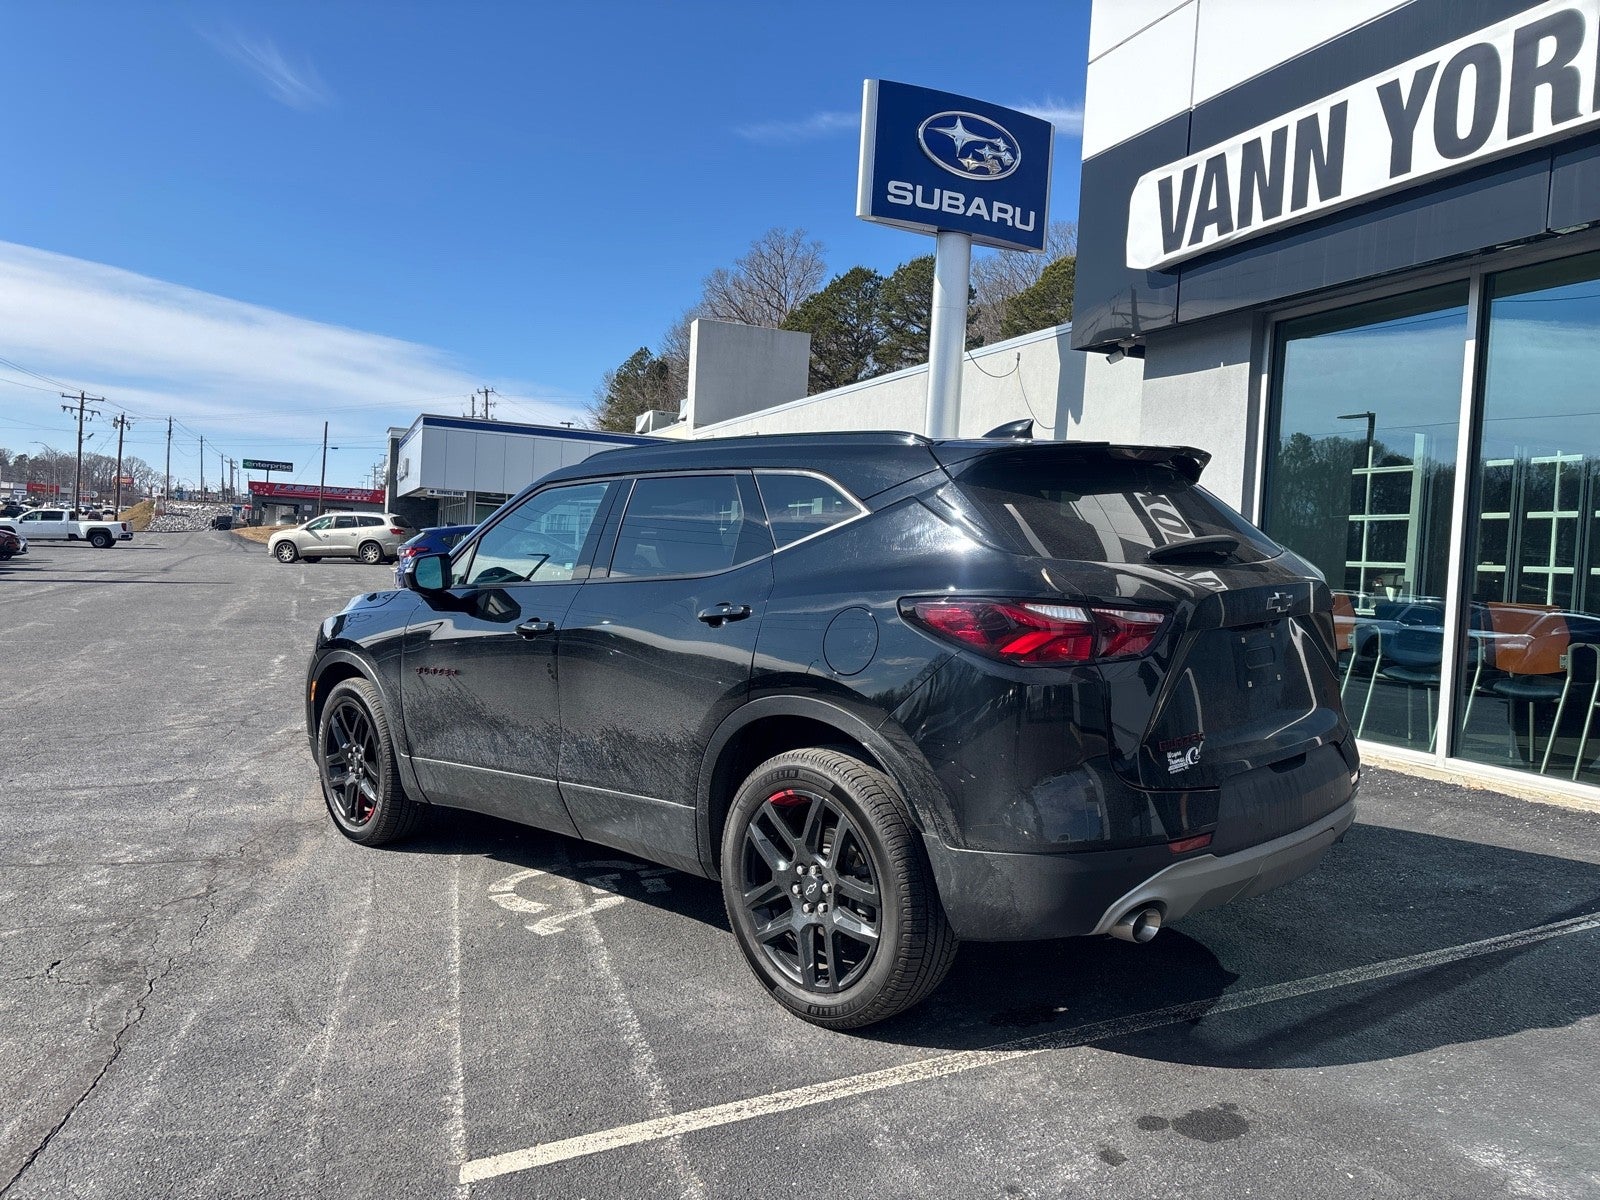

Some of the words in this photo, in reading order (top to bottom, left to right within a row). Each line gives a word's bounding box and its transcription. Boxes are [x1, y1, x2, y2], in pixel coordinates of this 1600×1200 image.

[1158, 100, 1348, 255] VANN
[1376, 8, 1600, 179] YOR
[887, 180, 1035, 232] SUBARU
[244, 460, 292, 470] enterprise
